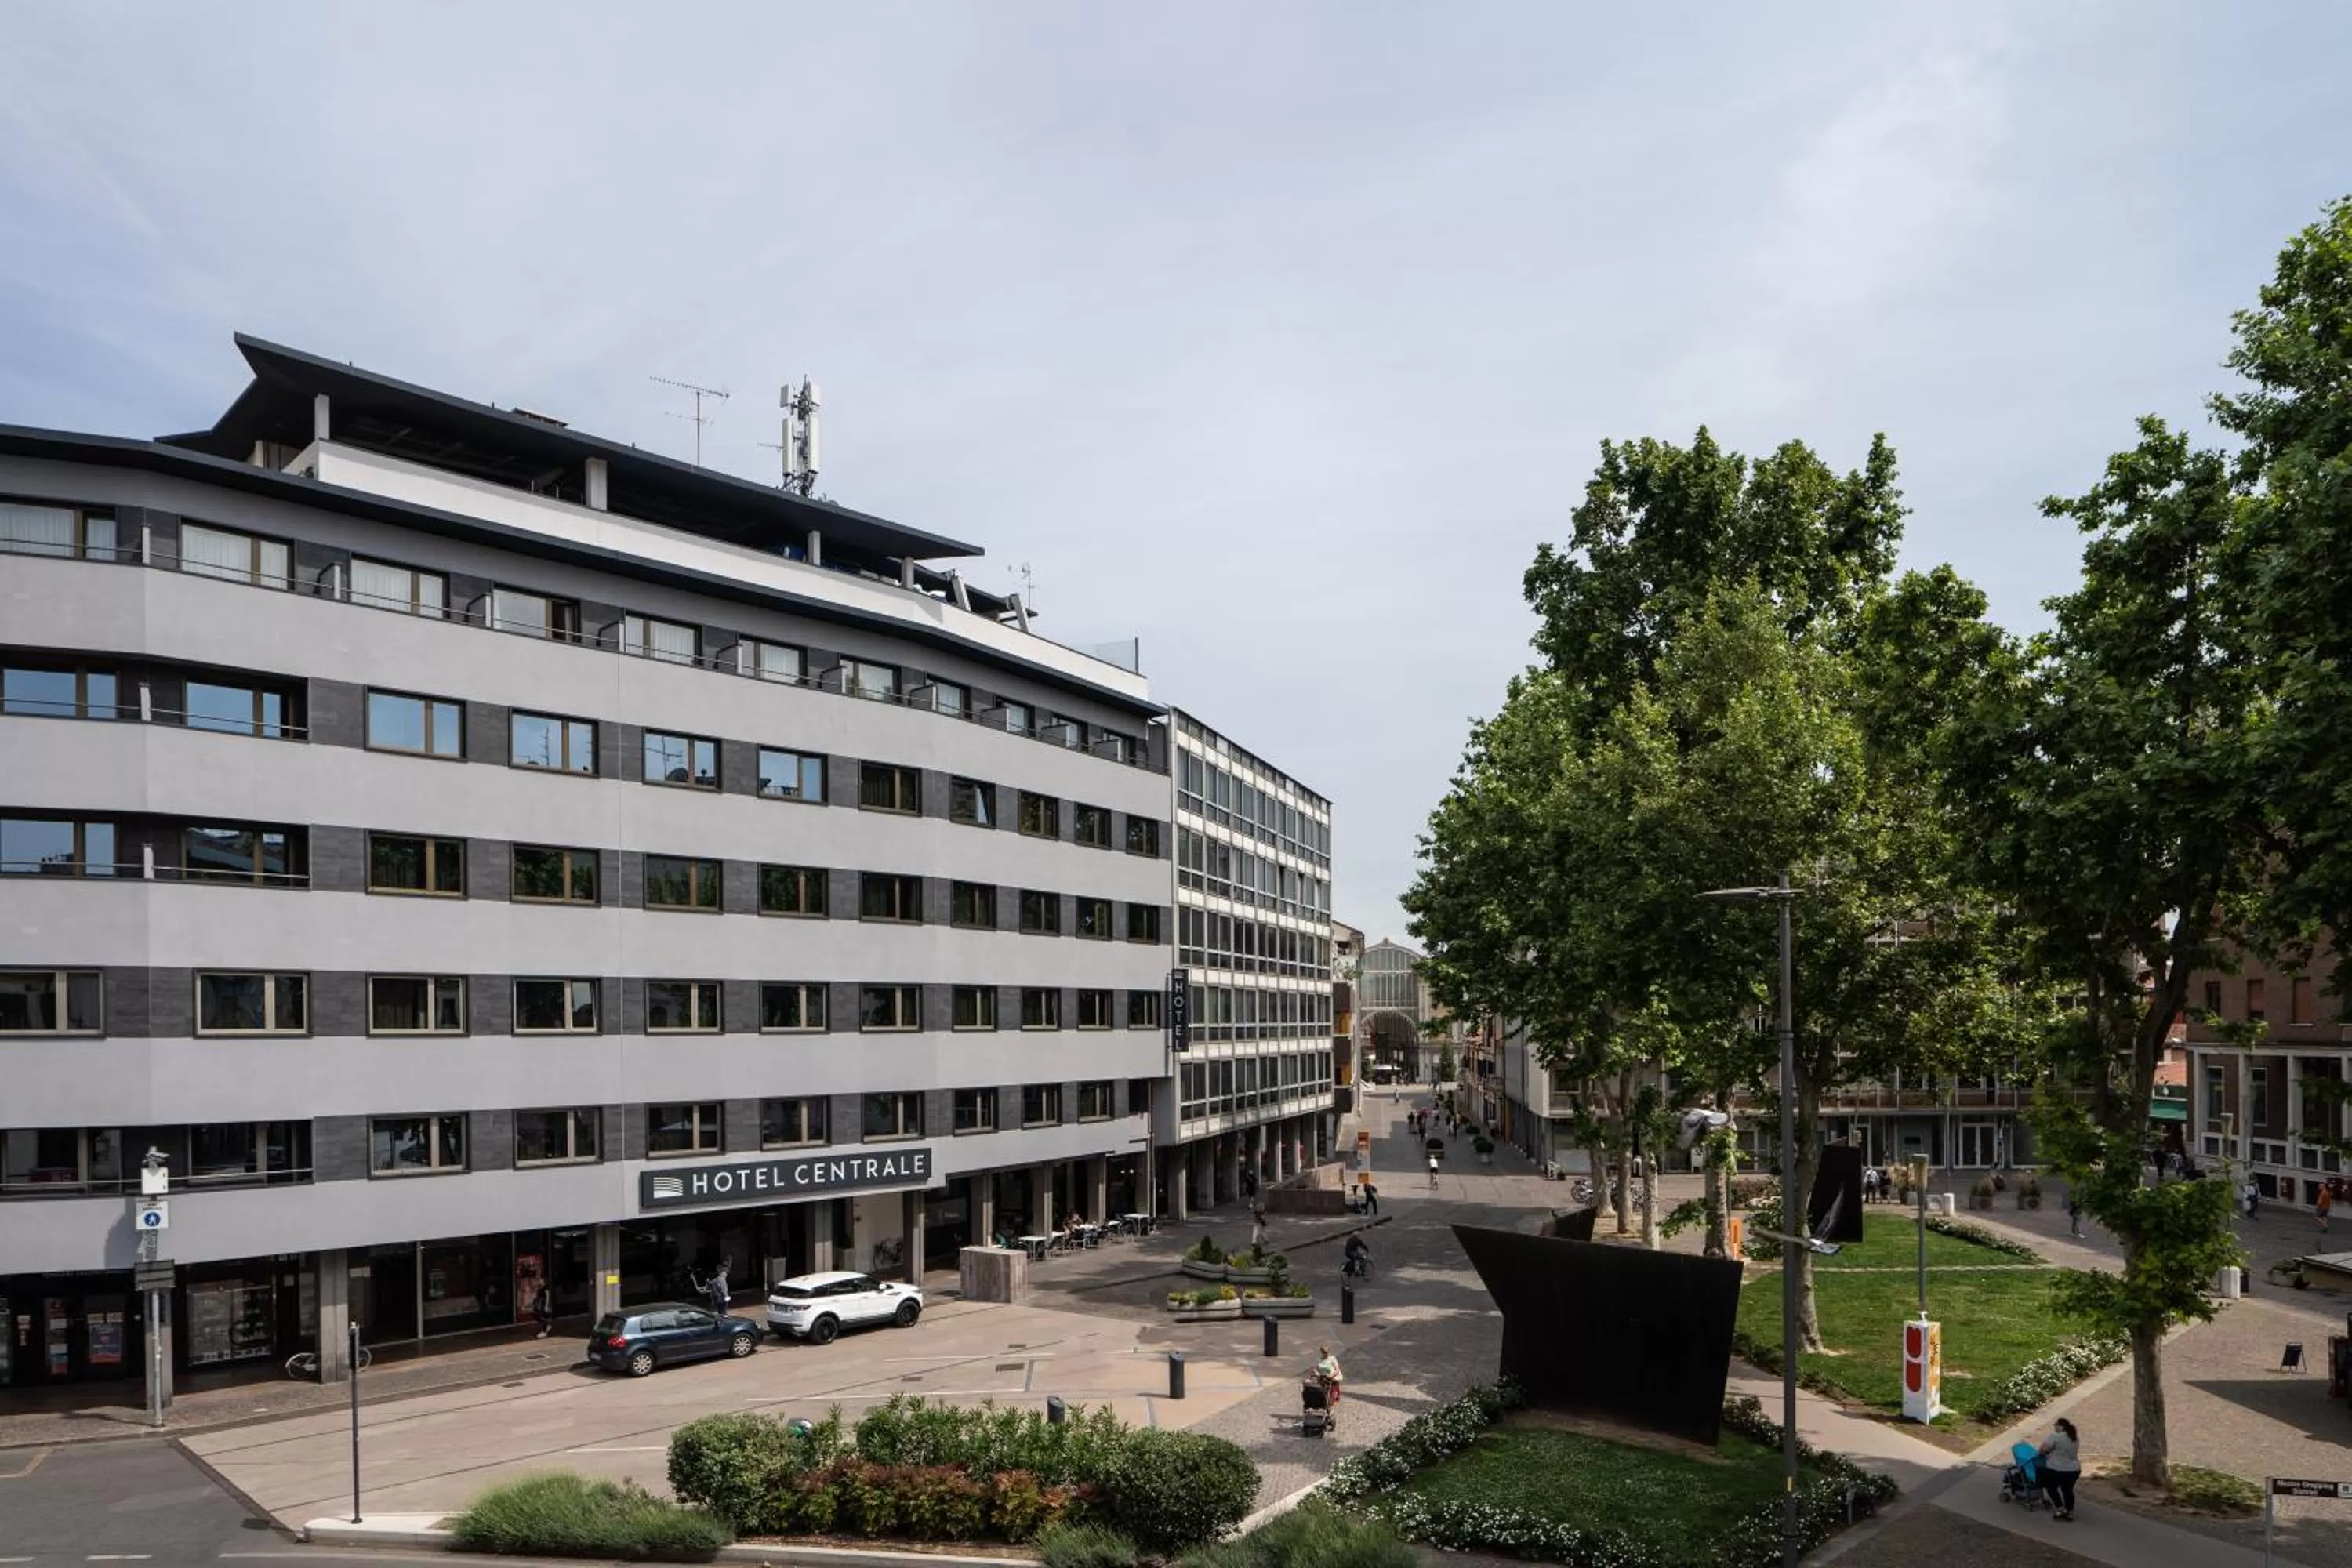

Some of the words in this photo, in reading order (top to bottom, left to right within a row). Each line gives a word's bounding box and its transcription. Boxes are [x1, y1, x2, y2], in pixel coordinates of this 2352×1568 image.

[1174, 981, 1184, 1050] HOTEL
[692, 1167, 784, 1194] HOTEL
[794, 1155, 925, 1185] CENTRALE
